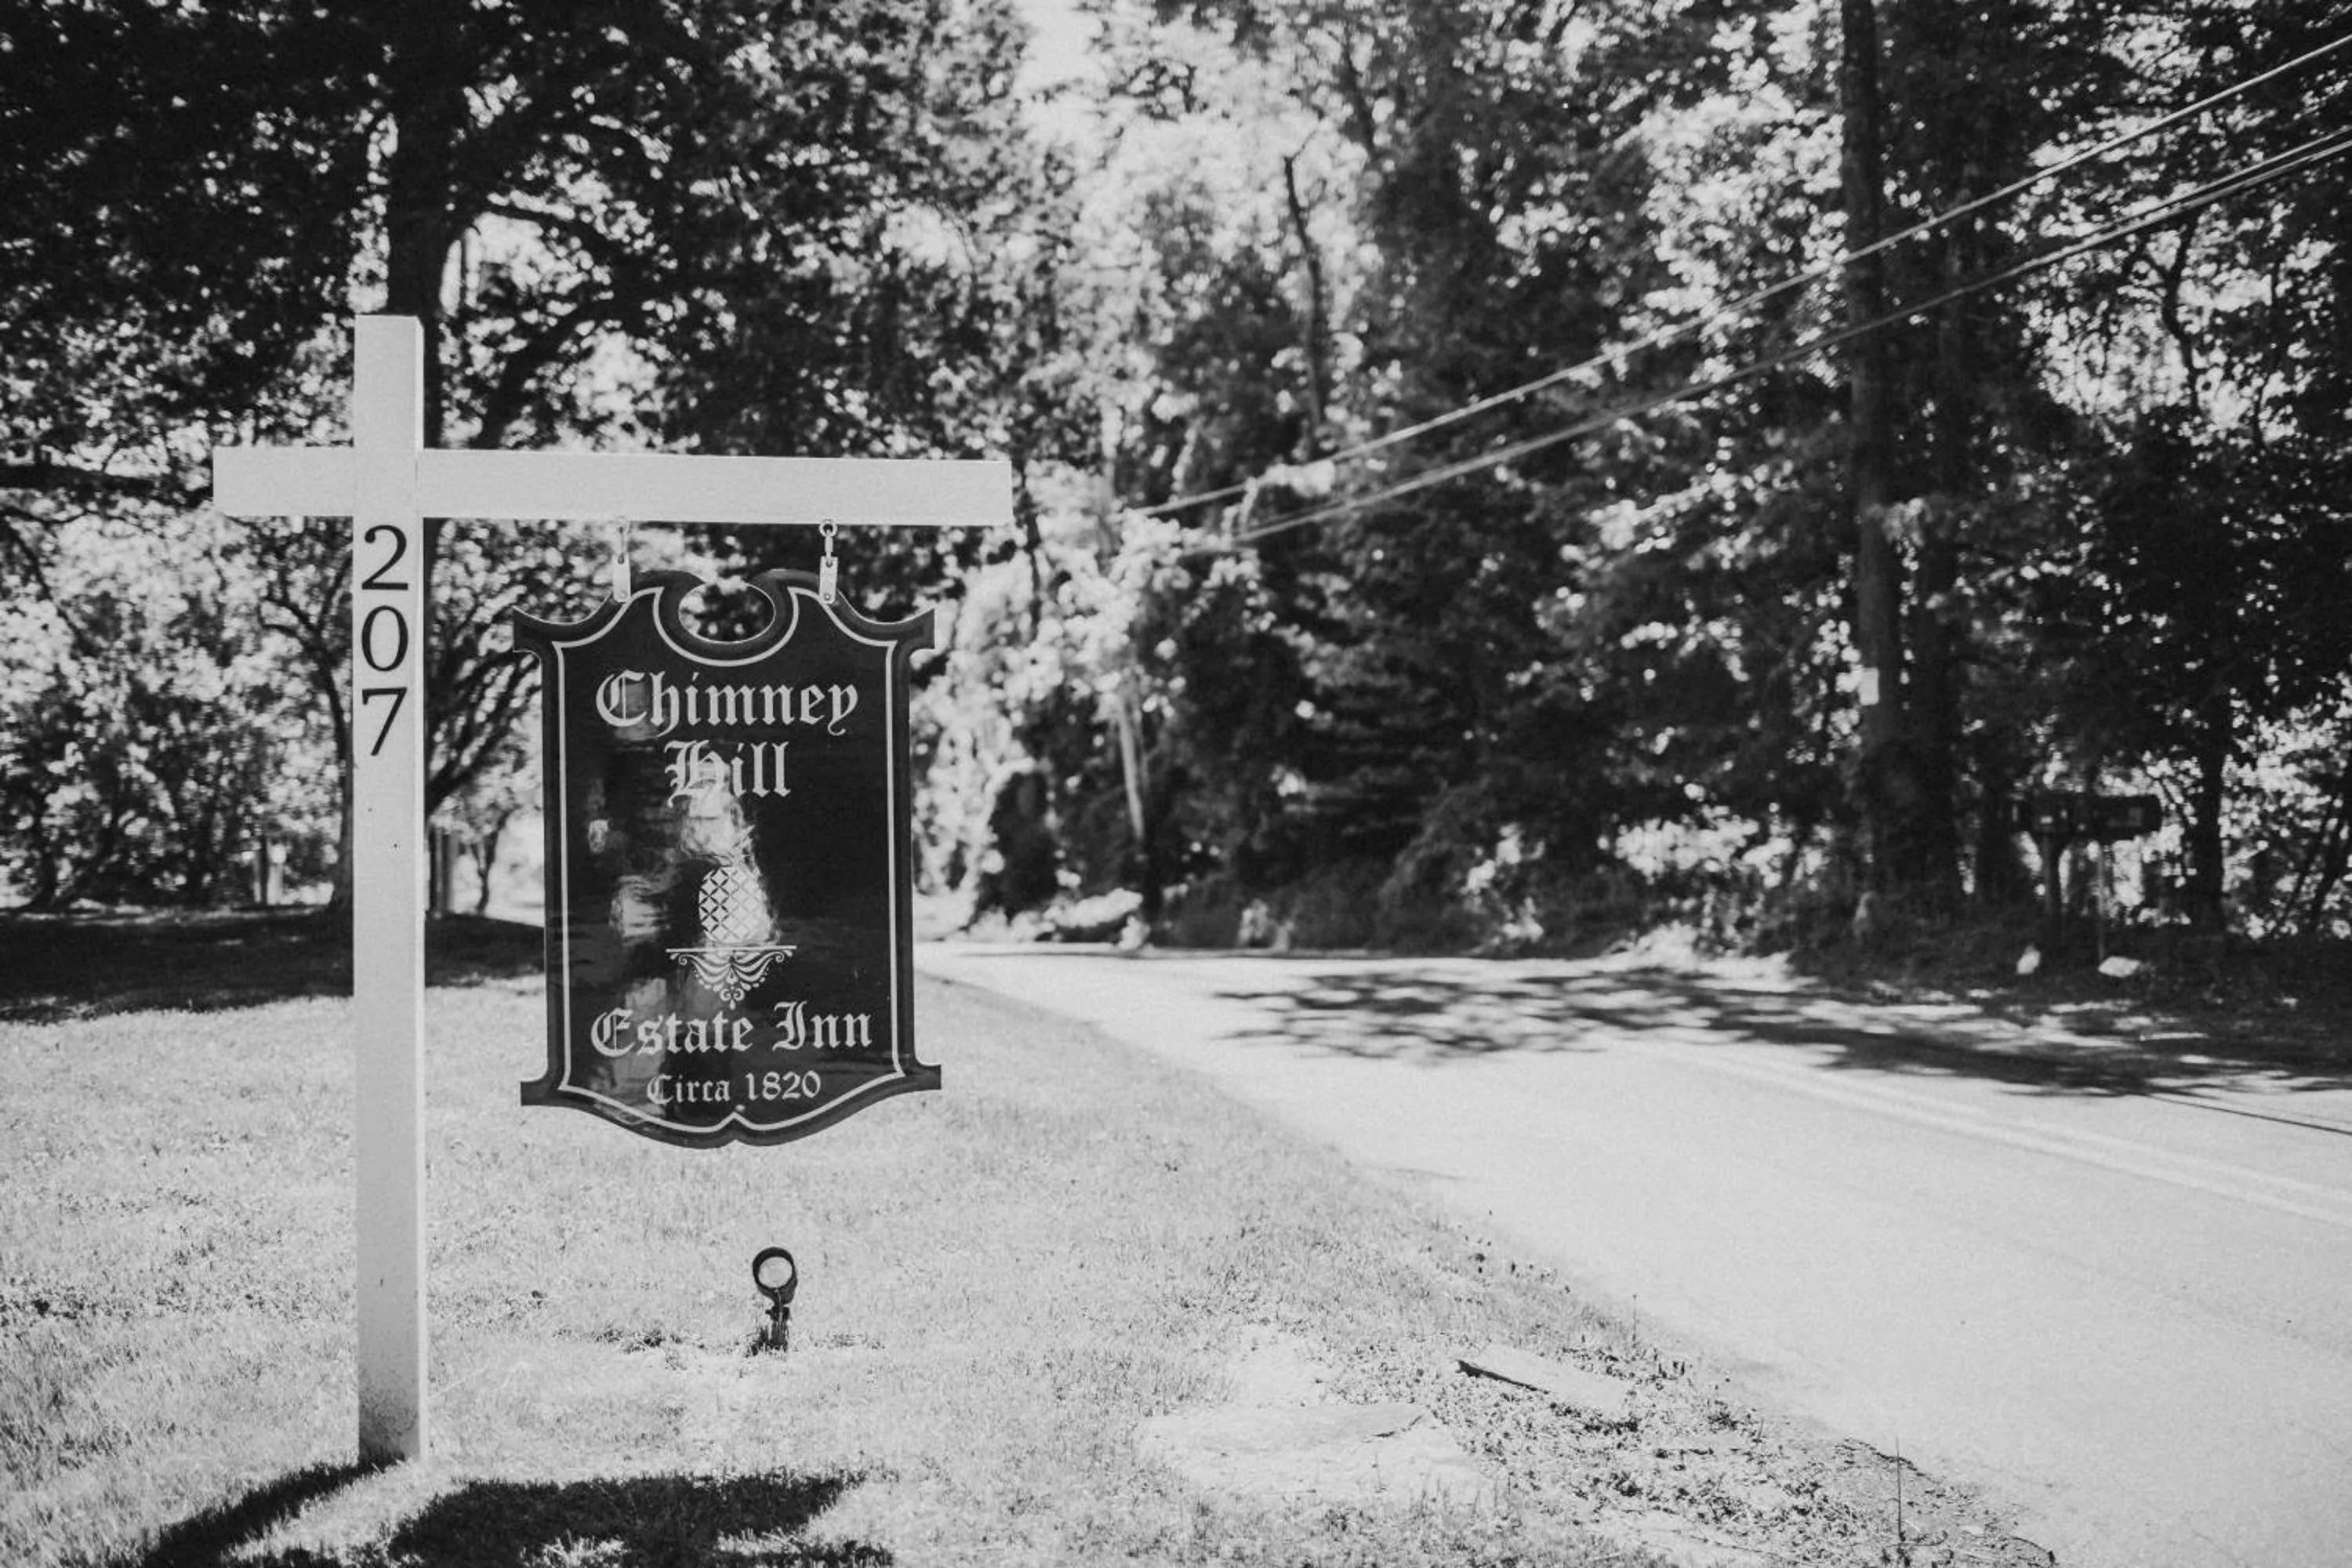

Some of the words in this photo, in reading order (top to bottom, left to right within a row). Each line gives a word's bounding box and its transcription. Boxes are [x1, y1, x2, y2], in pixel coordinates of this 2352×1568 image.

[361, 524, 408, 756] 207
[596, 670, 858, 736] Chimney
[664, 739, 791, 807] Hill
[591, 1007, 753, 1057] Estate
[772, 1000, 873, 1051] Inn
[646, 1074, 730, 1105] Circa
[745, 1070, 822, 1099] 1820
